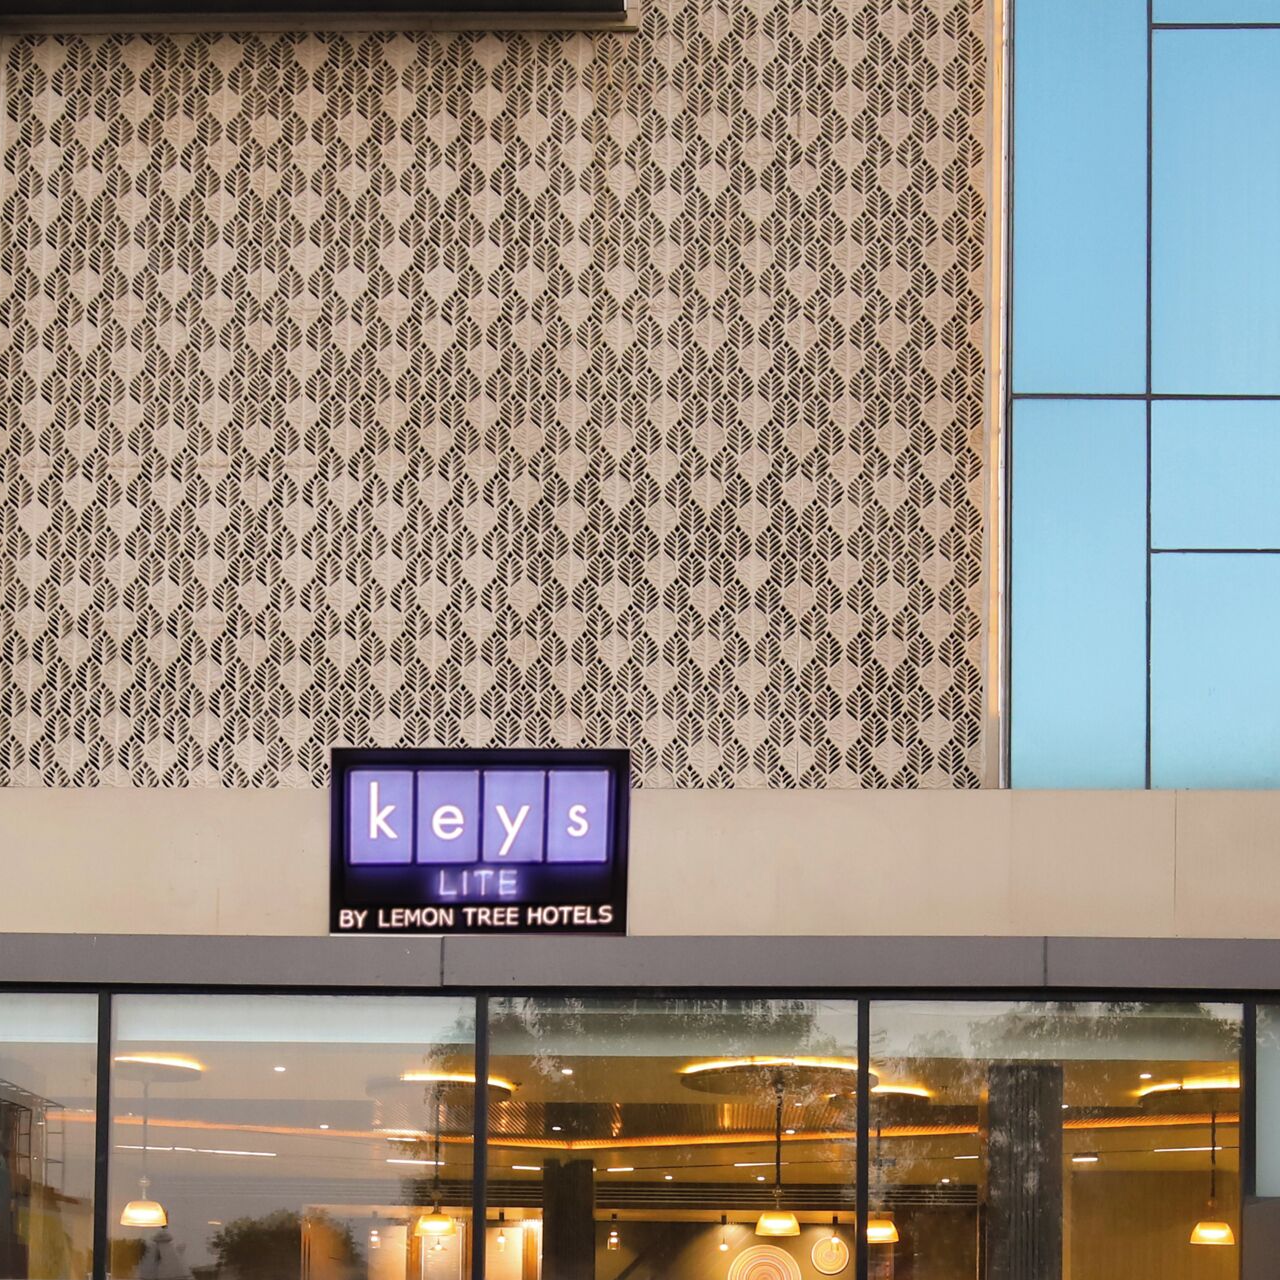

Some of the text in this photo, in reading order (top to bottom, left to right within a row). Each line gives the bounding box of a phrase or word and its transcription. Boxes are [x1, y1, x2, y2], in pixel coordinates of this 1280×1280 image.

[369, 781, 589, 856] keys
[438, 869, 518, 896] LITE
[338, 904, 613, 929] BY LEMON TREE HOTELS
